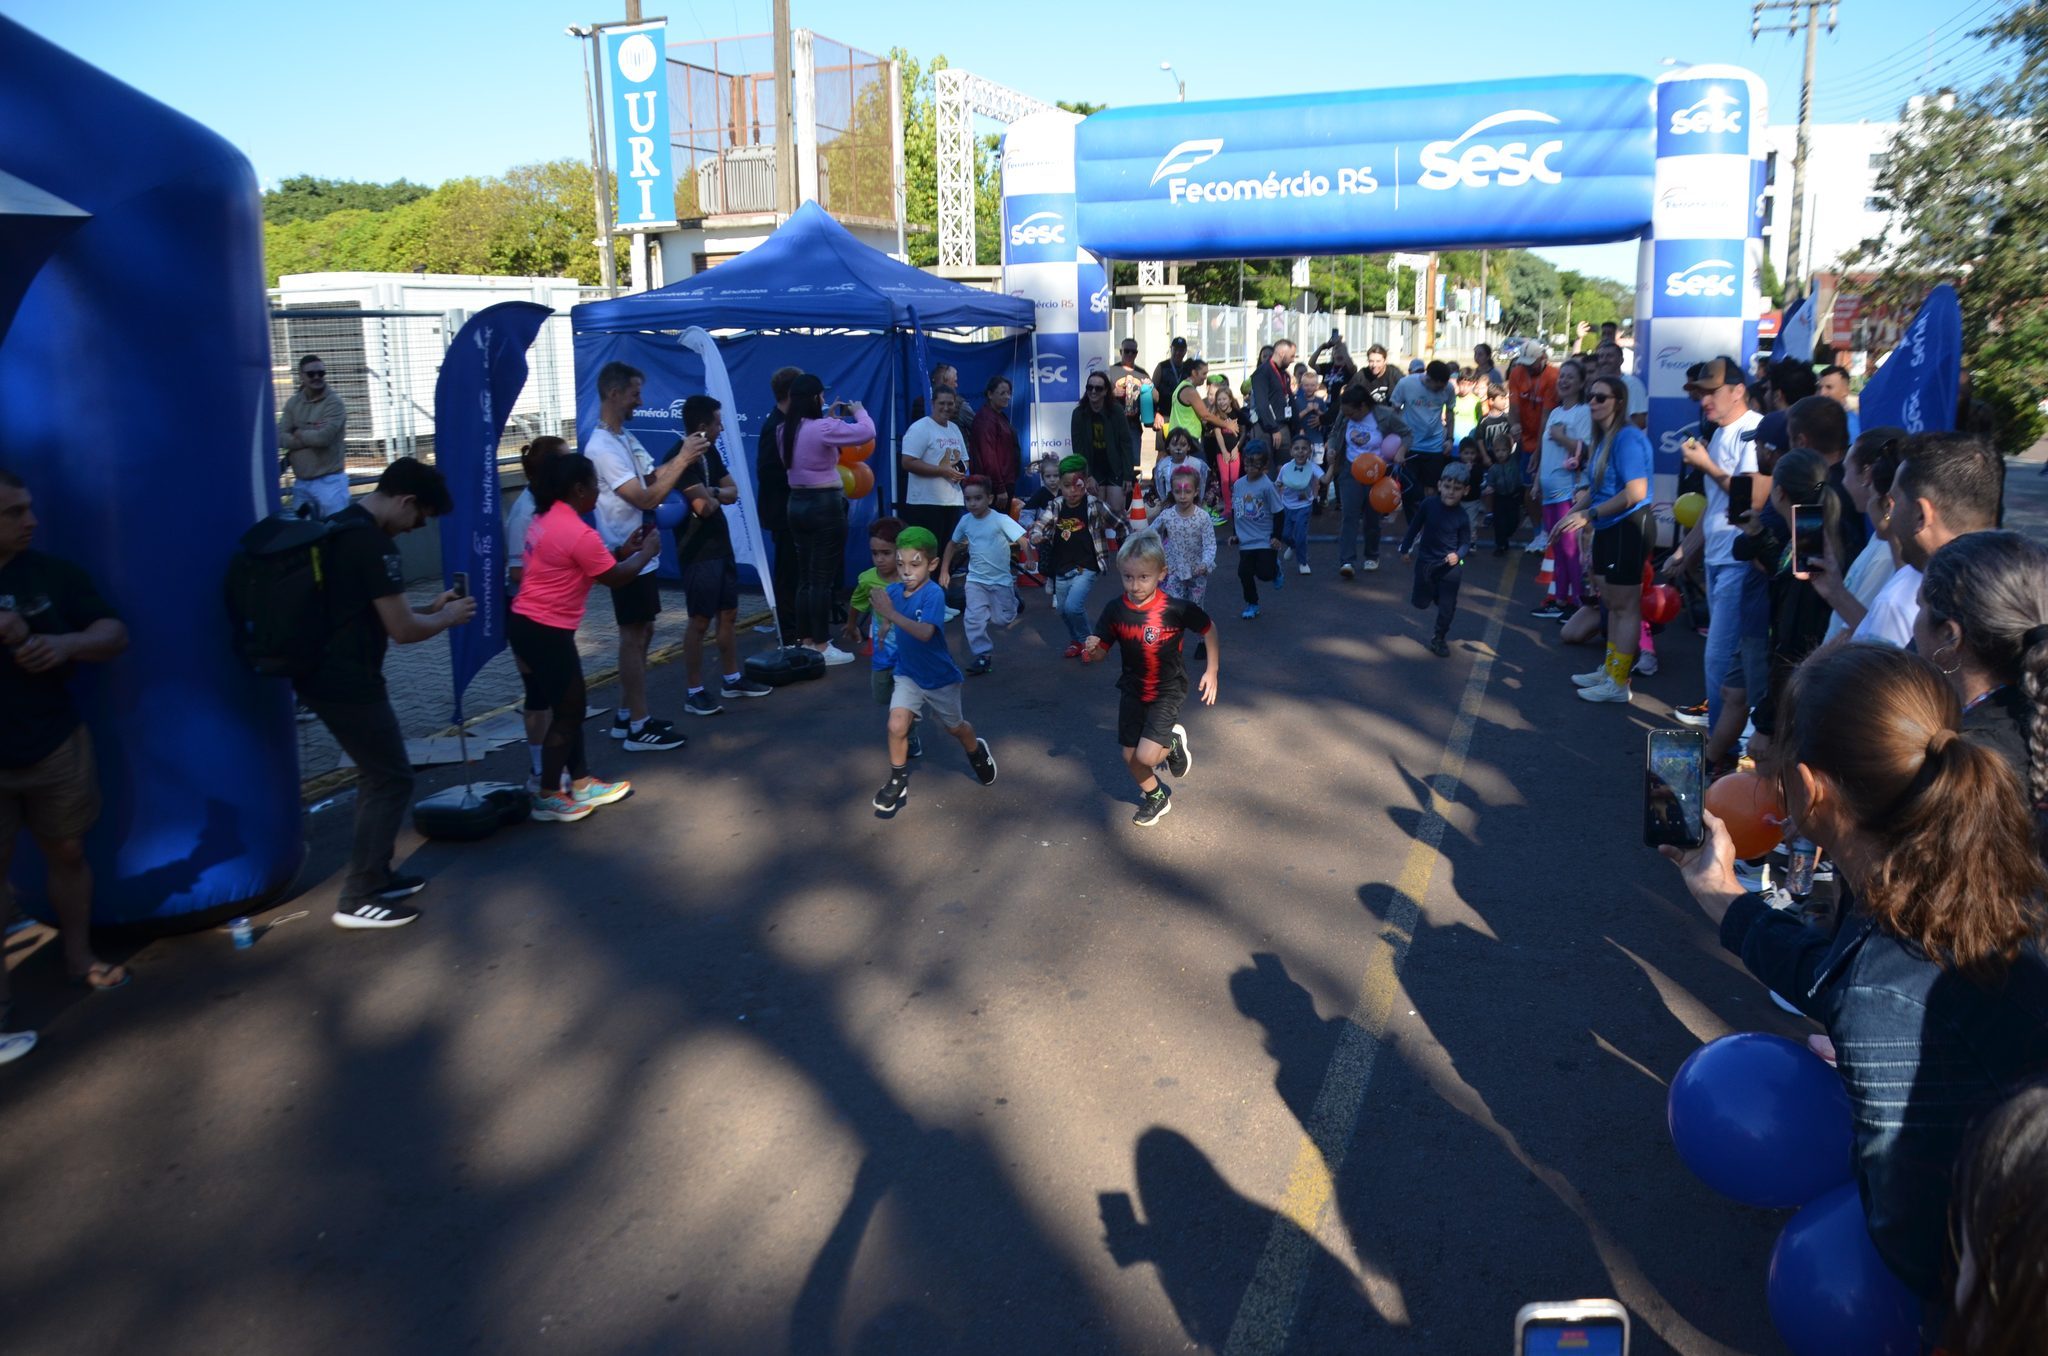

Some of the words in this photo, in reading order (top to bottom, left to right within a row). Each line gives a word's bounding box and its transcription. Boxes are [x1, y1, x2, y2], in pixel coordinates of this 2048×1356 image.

[614, 91, 661, 221] URI
[1169, 170, 1330, 204] Fecomércio
[1338, 166, 1378, 196] RS
[632, 408, 669, 418] omércio
[1031, 439, 1062, 447] mércio
[482, 444, 494, 514] Sindicatos
